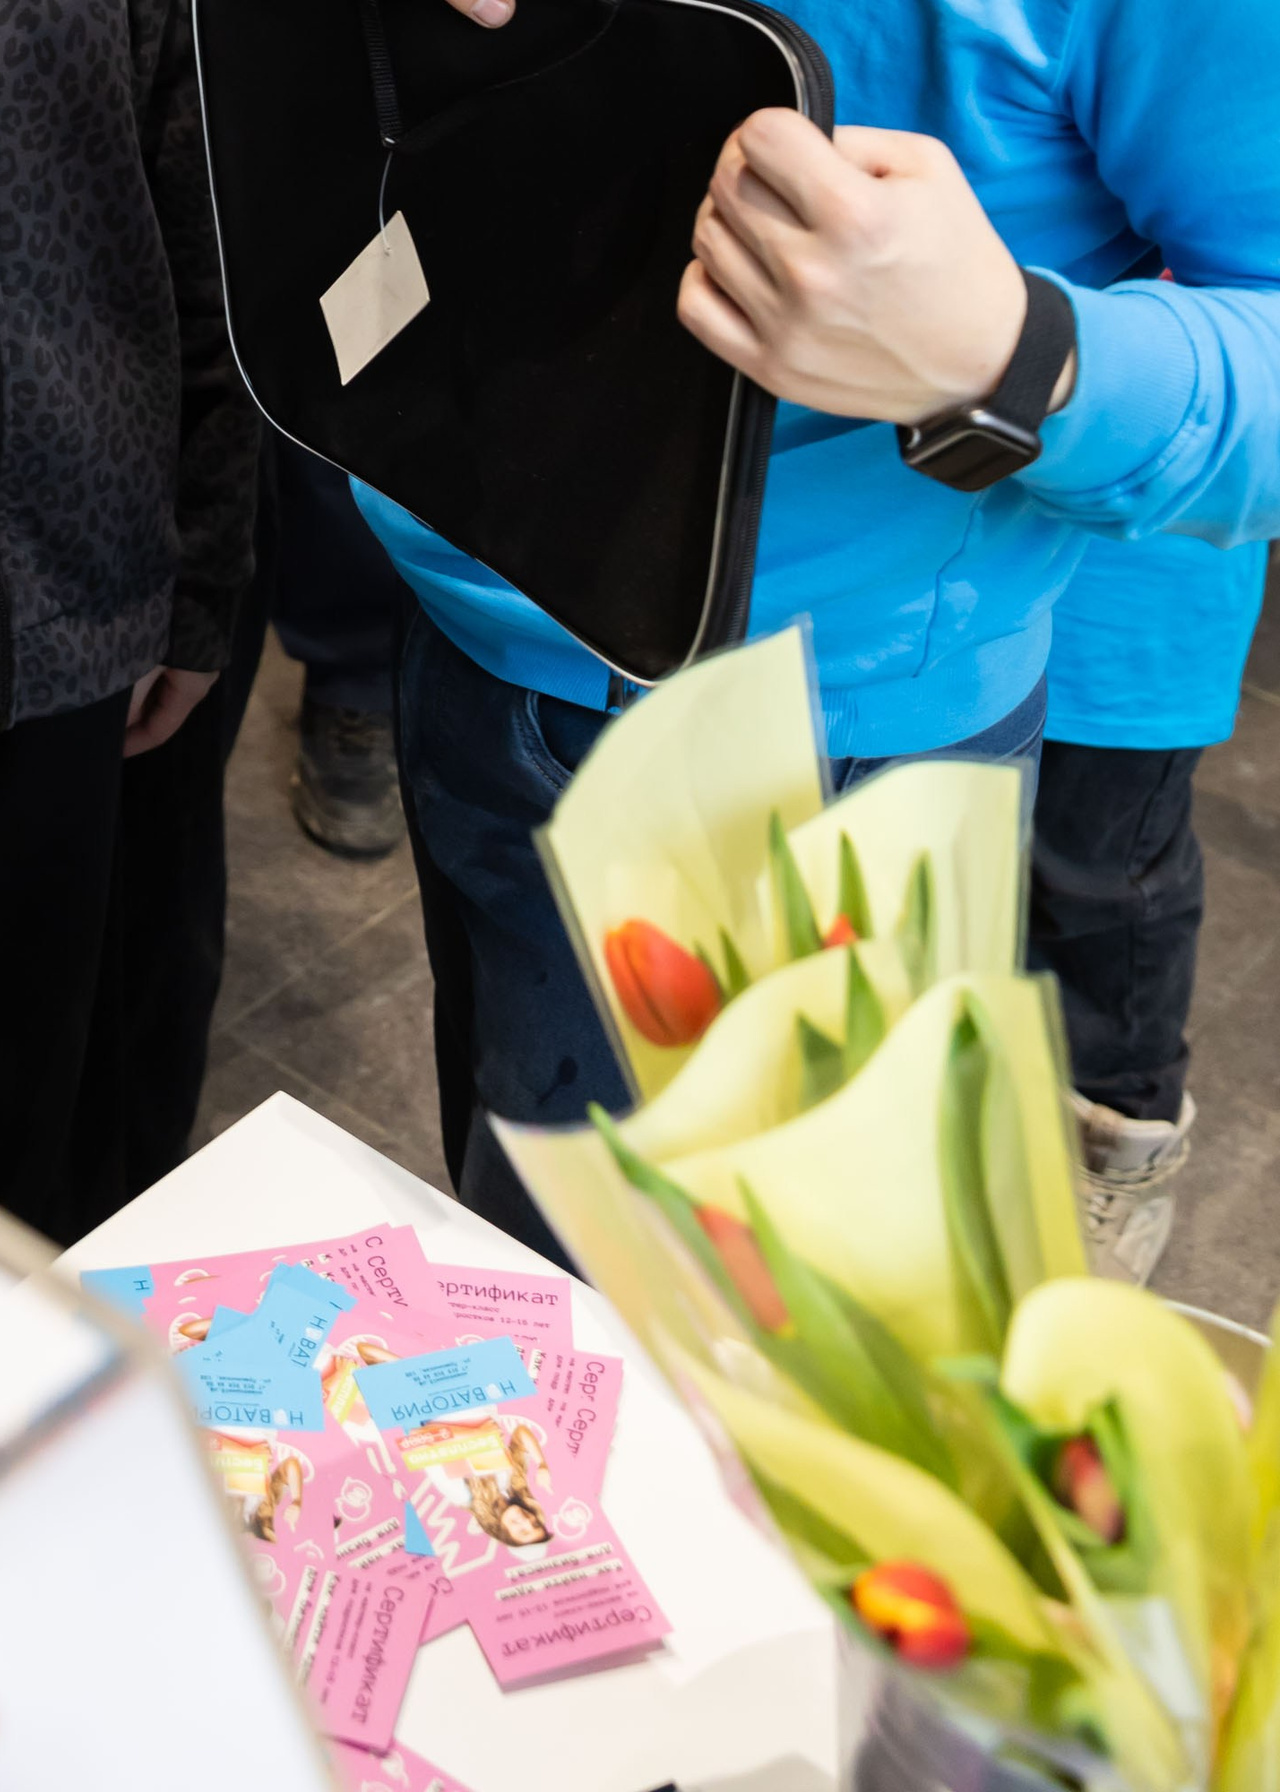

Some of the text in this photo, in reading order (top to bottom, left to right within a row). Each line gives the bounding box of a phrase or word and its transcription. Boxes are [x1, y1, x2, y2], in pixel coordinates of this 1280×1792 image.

[580, 1360, 606, 1402] Сер
[351, 1584, 405, 1725] Сертификат
[501, 1605, 653, 1657] Сертификат
